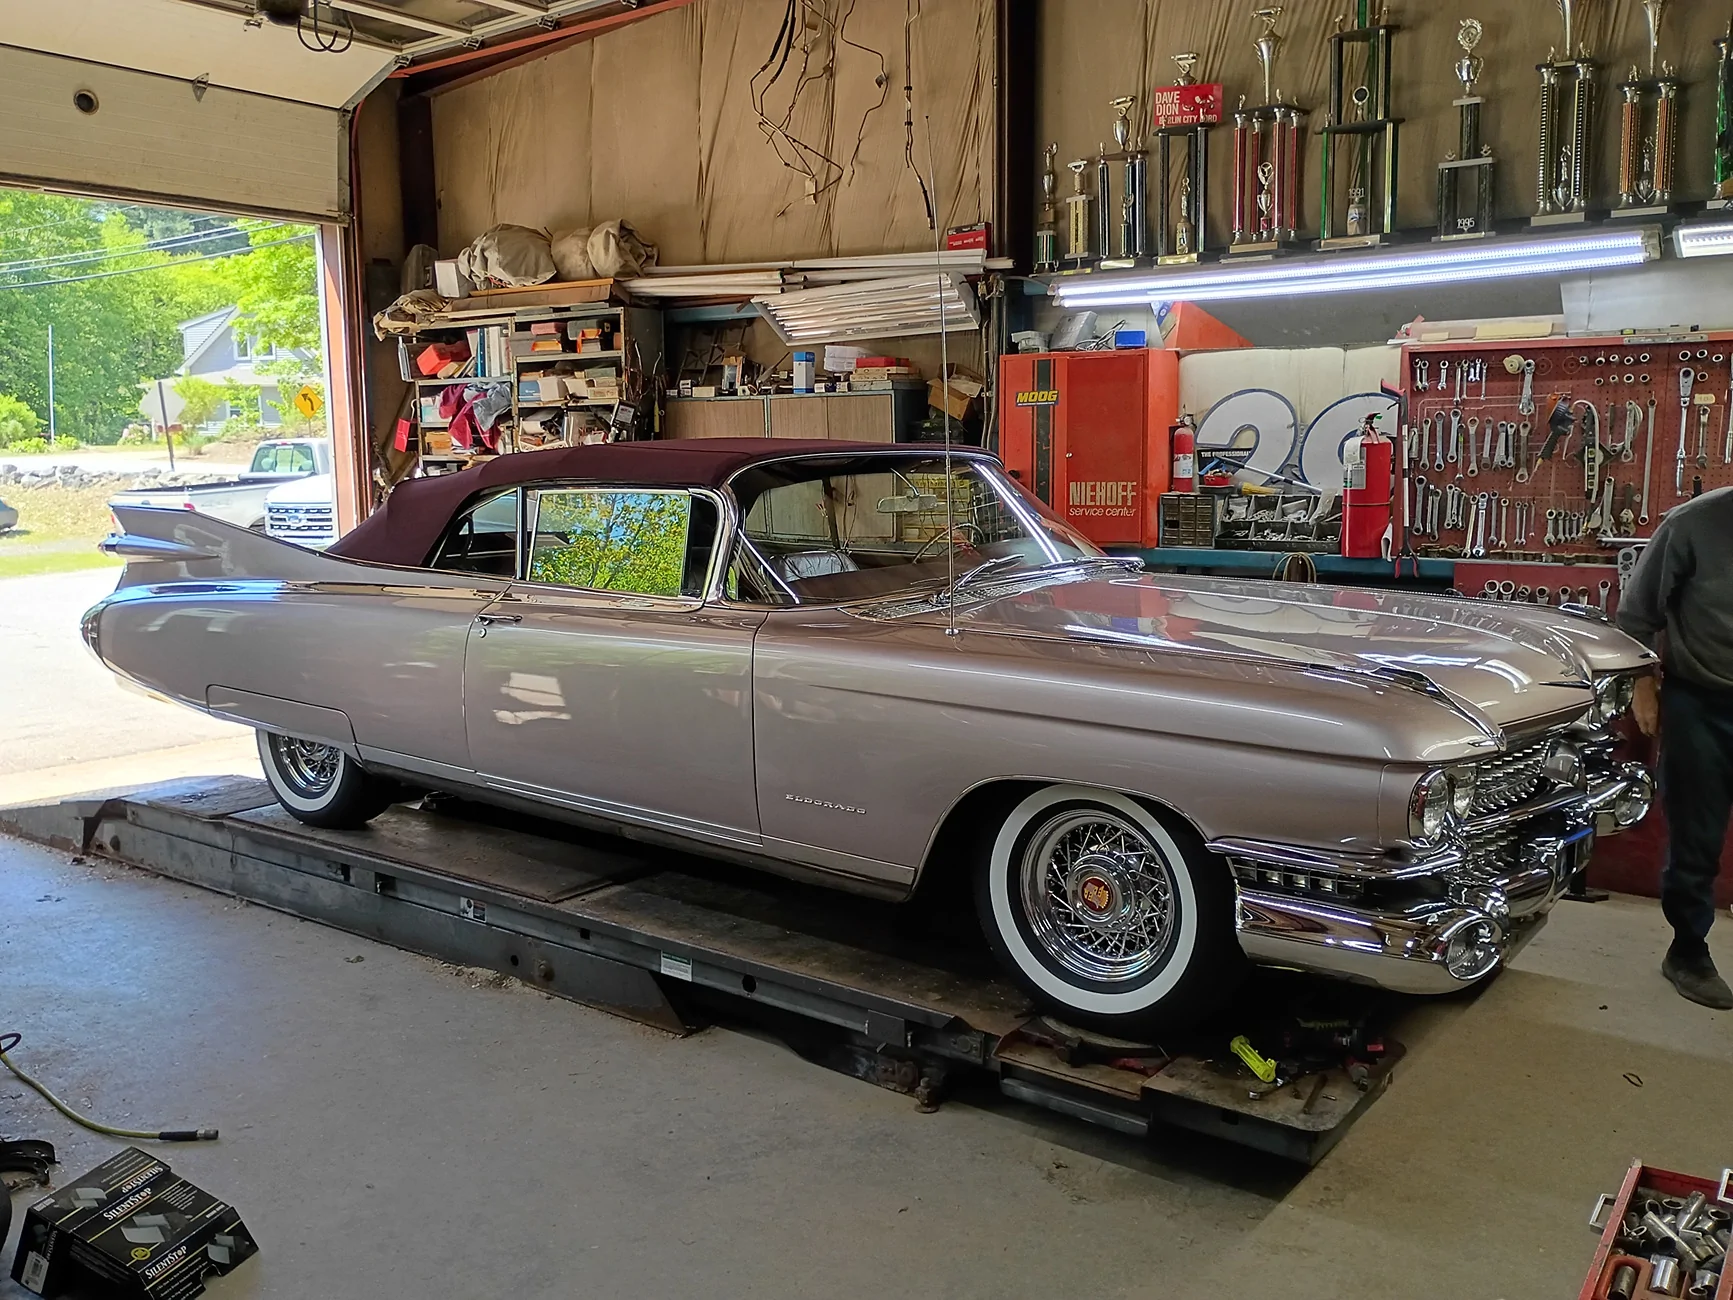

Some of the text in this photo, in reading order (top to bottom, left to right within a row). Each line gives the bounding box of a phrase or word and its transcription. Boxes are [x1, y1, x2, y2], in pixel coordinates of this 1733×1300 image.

[1155, 91, 1181, 105] DAVE
[1156, 103, 1179, 116] DION
[1158, 115, 1182, 125] BRLIN
[1182, 115, 1198, 124] CITY
[1456, 217, 1475, 229] 1995
[1016, 390, 1058, 403] MOOG
[1069, 481, 1137, 506] NIEHOFF
[1068, 506, 1137, 517] service center
[103, 1187, 153, 1221] SILENTSTOP
[144, 1245, 188, 1280] SILENTSTOP
